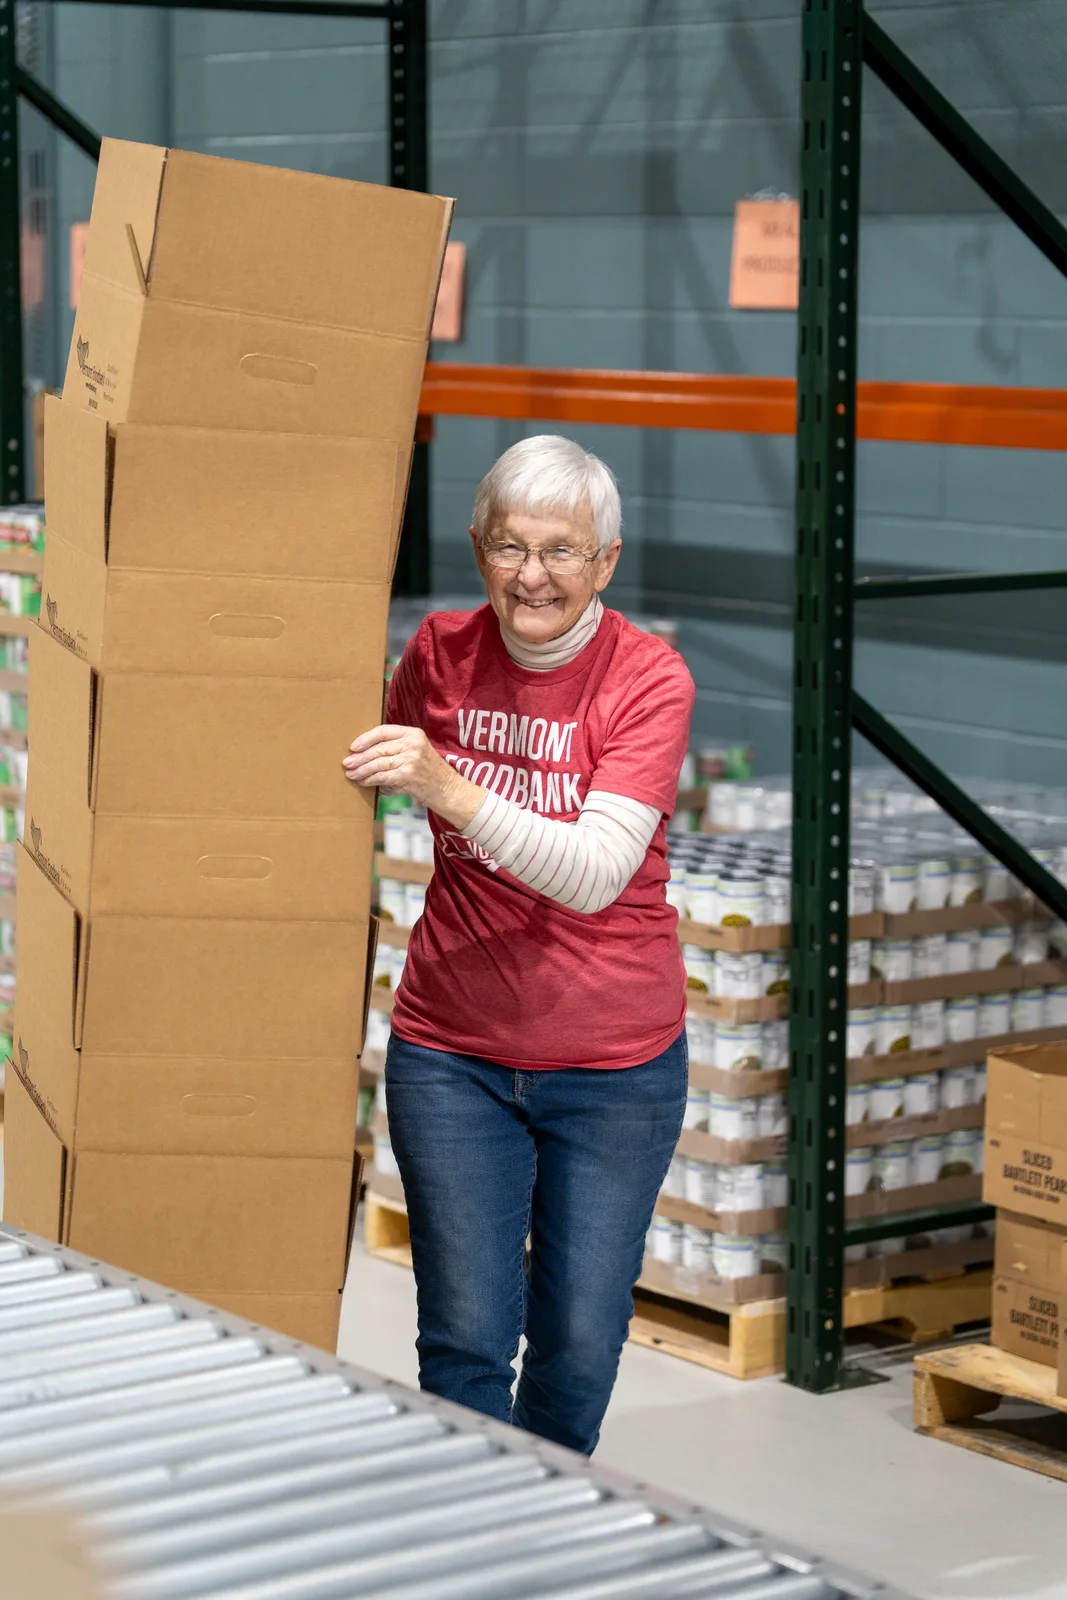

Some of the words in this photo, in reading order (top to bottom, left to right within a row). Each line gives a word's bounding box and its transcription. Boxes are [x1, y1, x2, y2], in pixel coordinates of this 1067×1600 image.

[457, 708, 578, 763] VERMONT
[1023, 1149, 1053, 1171] SLICED
[1003, 1164, 1042, 1188] BARTLETT
[1028, 1296, 1058, 1318] SLICED
[1010, 1308, 1049, 1333] BARTLETT
